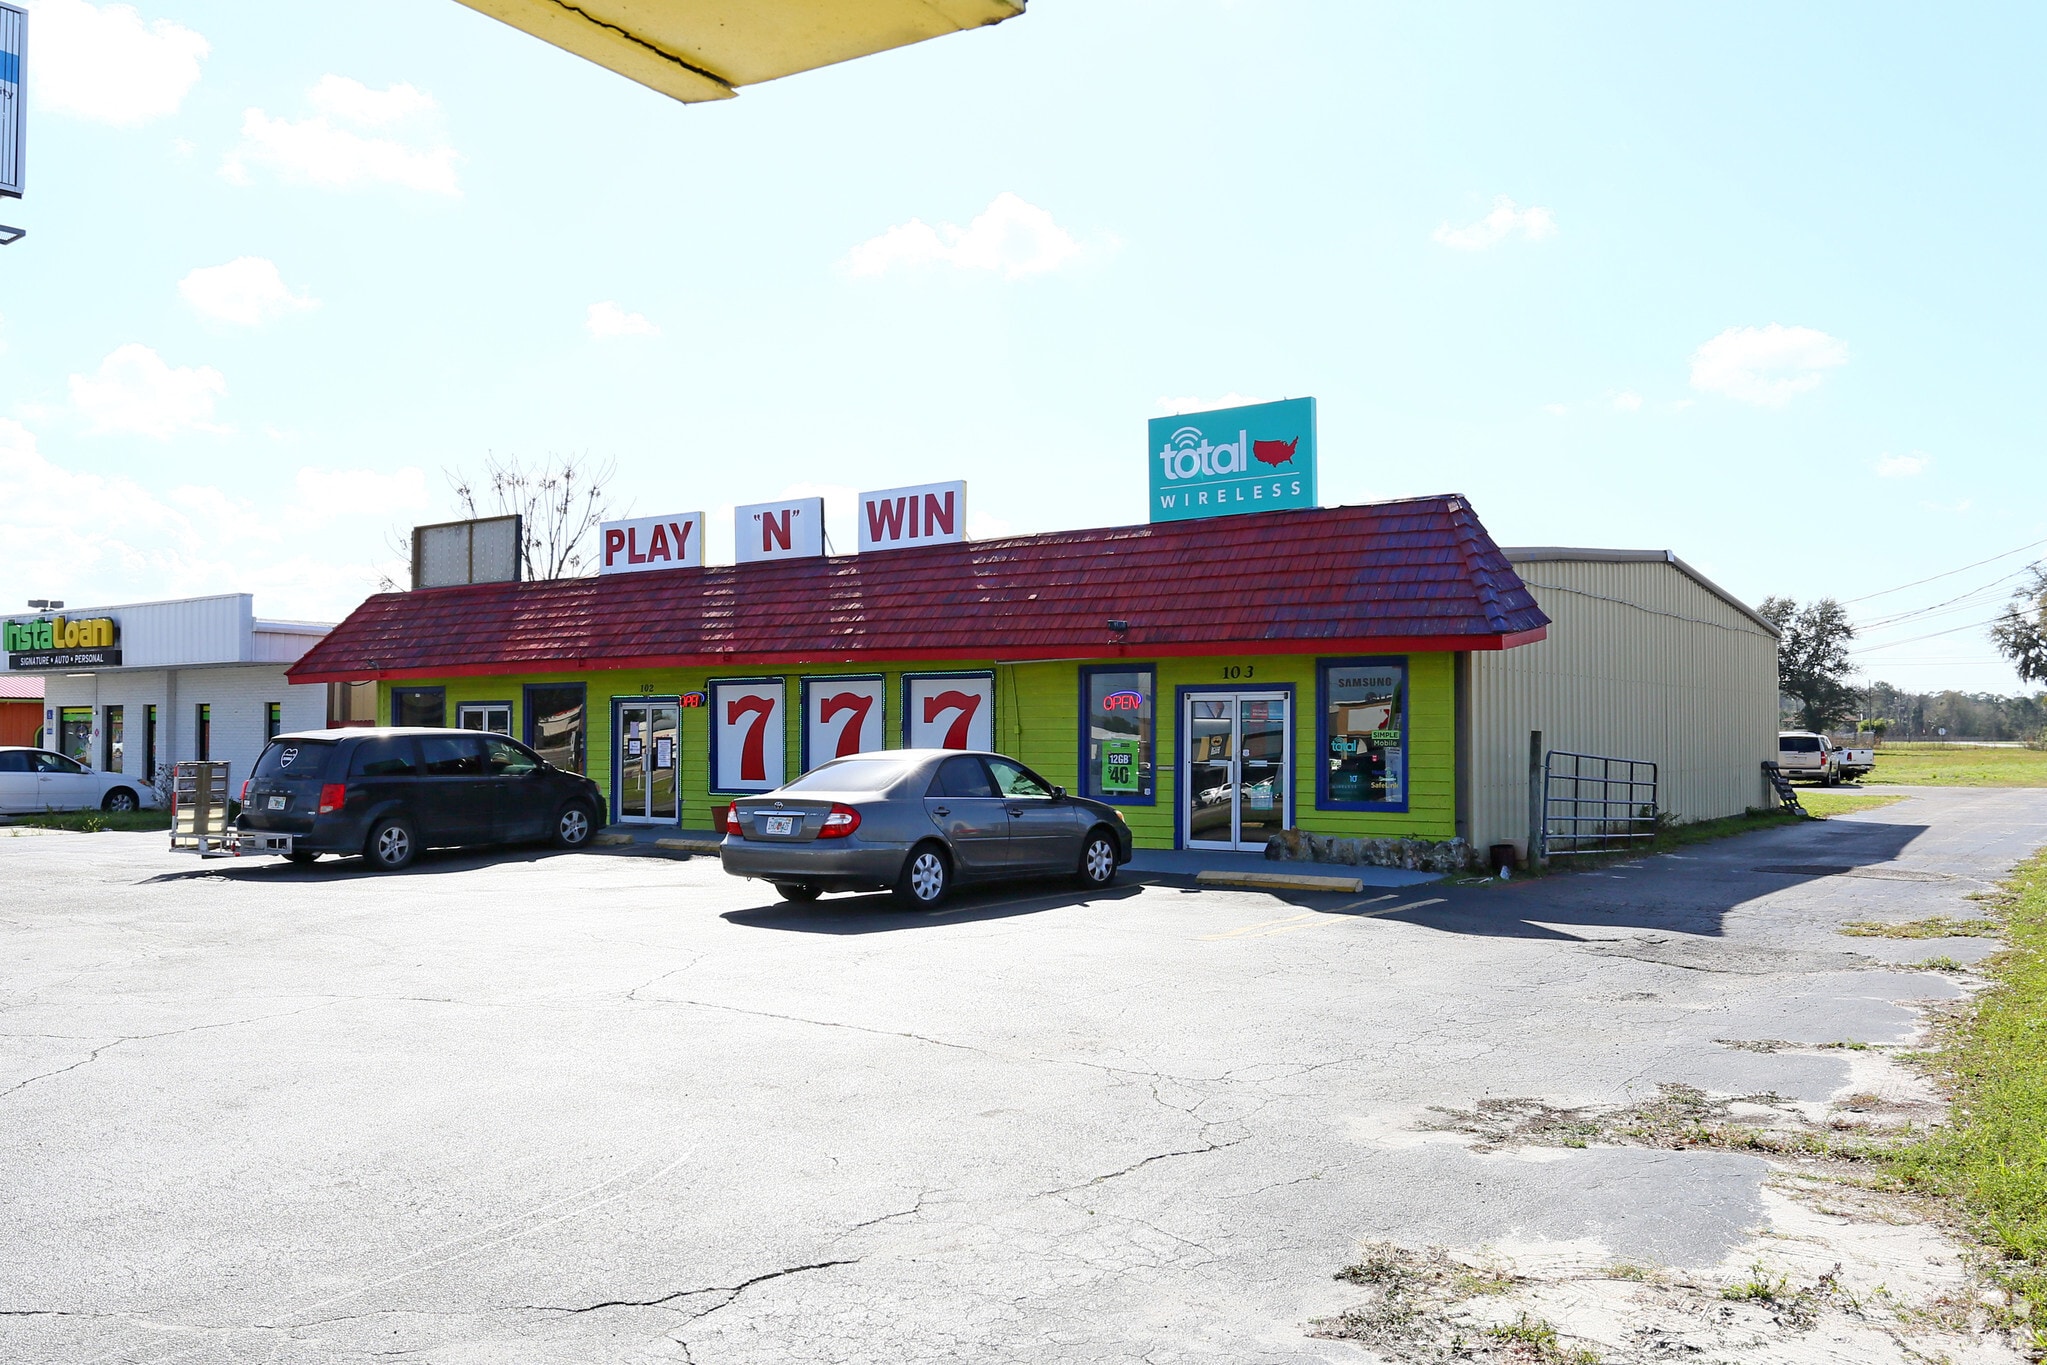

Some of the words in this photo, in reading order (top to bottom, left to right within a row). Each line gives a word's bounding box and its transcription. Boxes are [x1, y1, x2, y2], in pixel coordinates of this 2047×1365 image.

[1160, 429, 1247, 480] total
[1160, 481, 1300, 509] WIRELESS
[605, 521, 693, 567] PLAY
[866, 491, 954, 542] WIN
[3, 616, 114, 651] InstaLoan
[20, 656, 49, 666] SIGNATURE
[54, 655, 69, 664] AUTO
[75, 653, 104, 664] PERSONAL
[1223, 666, 1254, 679] 103
[640, 684, 654, 692] 102
[1338, 677, 1392, 688] SAMSUNG
[1103, 695, 1139, 710] OPEN
[727, 694, 775, 781] 7
[820, 691, 873, 758] 7
[923, 690, 981, 750] 7
[1373, 730, 1399, 739] SIMPLE
[1107, 765, 1129, 784] $40
[1371, 781, 1399, 789] SafeLnk
